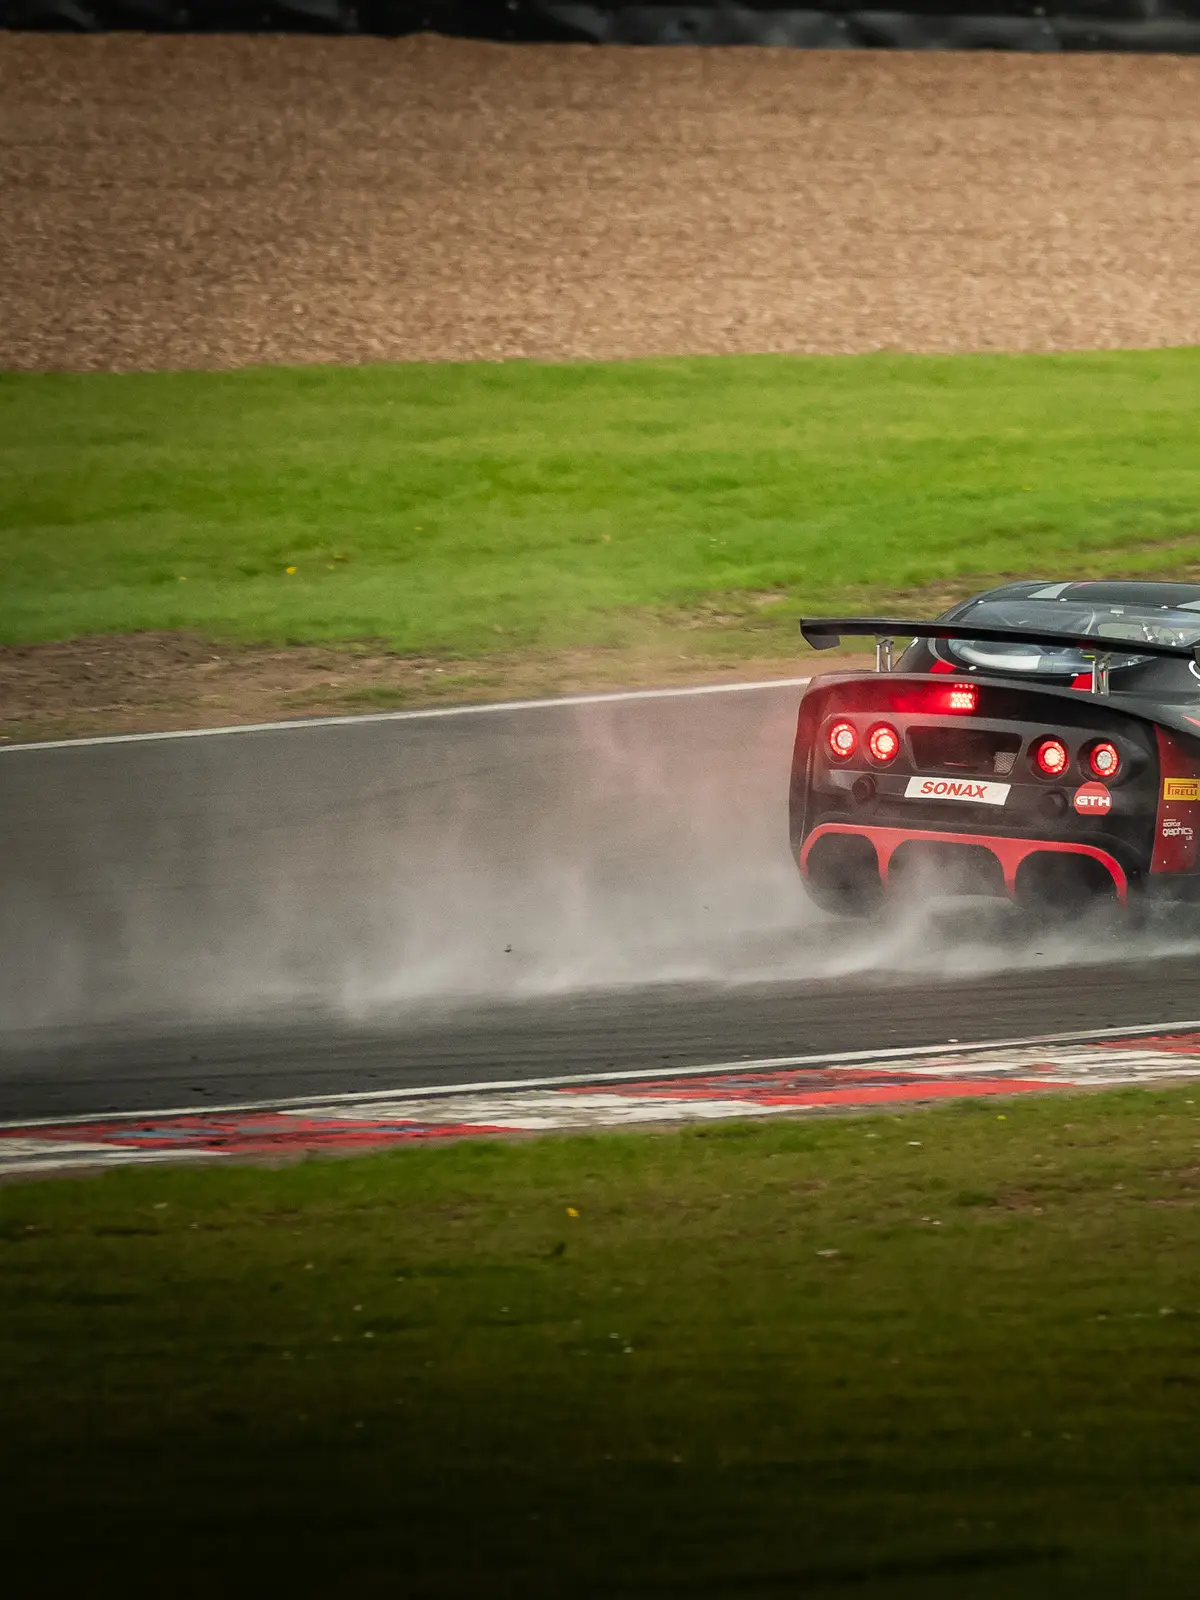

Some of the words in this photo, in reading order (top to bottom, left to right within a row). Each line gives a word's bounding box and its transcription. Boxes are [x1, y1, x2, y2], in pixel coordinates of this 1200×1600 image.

[920, 781, 988, 799] SONAX
[1167, 783, 1198, 796] PIRELLI
[1076, 795, 1111, 807] GTH
